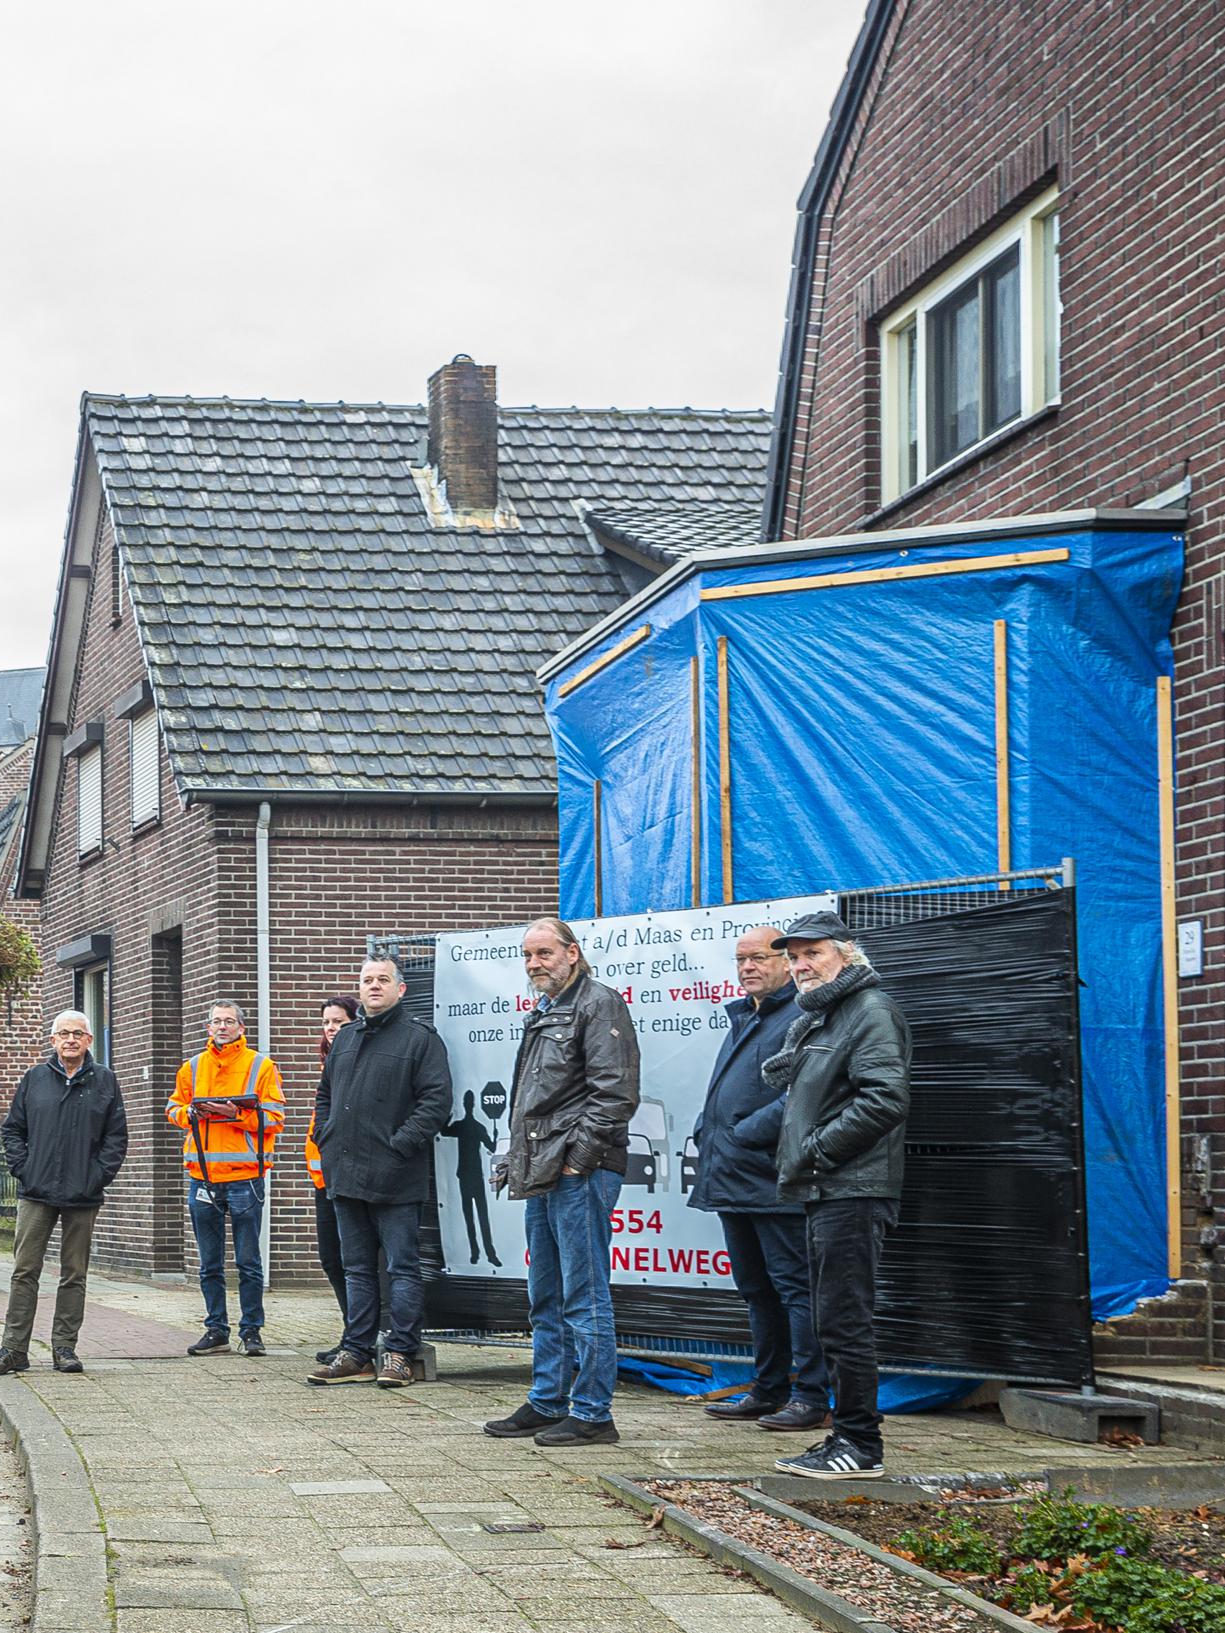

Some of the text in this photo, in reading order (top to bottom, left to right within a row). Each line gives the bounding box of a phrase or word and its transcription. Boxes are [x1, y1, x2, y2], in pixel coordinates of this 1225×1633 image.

[450, 943, 525, 962] Gemeent
[592, 928, 628, 953] a/d
[633, 926, 683, 946] Maas
[690, 926, 714, 942] en
[606, 959, 646, 978] over
[650, 953, 705, 979] geld...
[447, 1001, 486, 1017] maar
[491, 997, 510, 1013] de
[640, 987, 662, 1004] en
[668, 979, 748, 1006] veilighe
[468, 1027, 504, 1043] onze
[651, 1012, 702, 1037] enige
[708, 1010, 730, 1030] da
[483, 1094, 506, 1105] STOP
[612, 1246, 732, 1276] NELWEG
